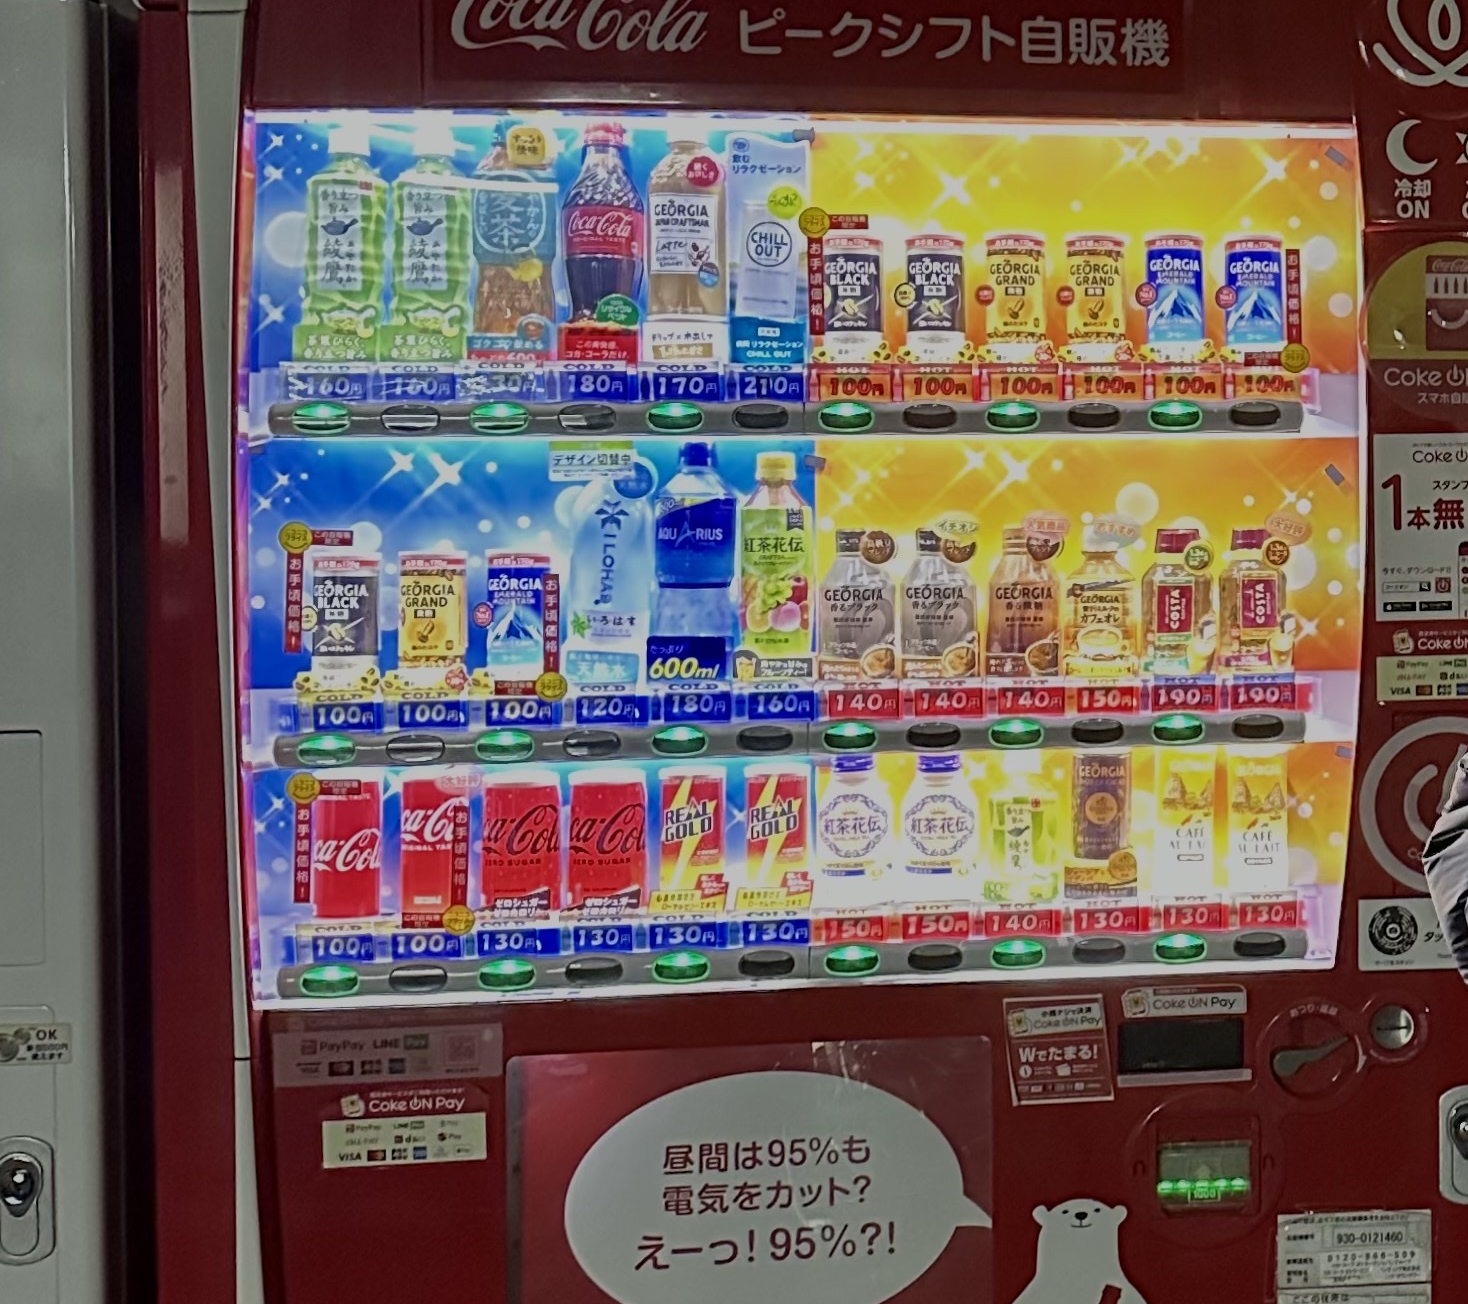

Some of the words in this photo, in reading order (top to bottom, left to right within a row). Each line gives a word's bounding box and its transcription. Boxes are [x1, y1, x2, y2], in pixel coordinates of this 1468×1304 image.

[738, 8, 1171, 69] ピークシフト自販機
[1394, 178, 1432, 197] 冷却
[654, 198, 710, 218] GEORGIA
[1396, 200, 1431, 219] ON
[567, 211, 634, 239] Coca-Cola
[750, 231, 789, 246] CHILL
[754, 243, 783, 259] OUT
[909, 258, 962, 276] GEORGIA
[989, 259, 1041, 275] GEORGIA
[1069, 260, 1121, 276] GEORGIA
[1149, 254, 1201, 272] GEORGIA
[1229, 257, 1281, 275] GEORGIA
[829, 274, 871, 286] BLACK
[914, 274, 956, 287] BLACK
[995, 274, 1036, 286] GRAND
[1075, 275, 1115, 287] GRAND
[567, 374, 625, 394] 180円
[658, 375, 718, 395] 170円
[744, 375, 801, 395] 210円
[1000, 376, 1054, 396] 100円
[1084, 375, 1136, 395] 100円
[1164, 375, 1216, 395] 100円
[1244, 374, 1295, 394] 100円
[1383, 367, 1442, 387] Coke
[830, 377, 884, 396] 100円
[914, 377, 967, 396] 100円
[552, 453, 632, 466] デザイン切替中
[1412, 450, 1453, 463] Coke
[743, 536, 805, 553] 紅茶花伝
[401, 580, 456, 597] GEORGIA
[488, 573, 543, 591] GEORGIA
[824, 585, 884, 602] GEORGIA
[906, 583, 965, 600] GEORGIA
[995, 583, 1054, 601] GEORGIA
[1080, 592, 1121, 604] GEORGIA
[317, 596, 360, 609] BLACK
[405, 596, 448, 608] GRAND
[830, 603, 879, 613] 香るブラック
[911, 600, 960, 611] 香るブラック
[1169, 588, 1181, 631] COSTA
[1255, 582, 1266, 625] COSTA
[1417, 638, 1452, 651] Coke
[649, 657, 720, 680] 600ml
[671, 696, 726, 714] 180円
[756, 696, 810, 712] 160円
[836, 694, 897, 711] 140円
[921, 692, 980, 710] 140円
[1003, 691, 1062, 708] 140円
[1081, 691, 1132, 708] 150円
[316, 706, 374, 724] 100円
[490, 701, 551, 719] 100円
[1079, 761, 1126, 778] GEORGIA
[664, 799, 710, 824] REAL
[750, 799, 795, 821] REAL
[664, 815, 713, 843] GOLD
[750, 815, 798, 841] GOLD
[824, 815, 882, 835] 紅茶花伝
[911, 815, 969, 835] 紅茶花伝
[992, 914, 1050, 931] 140円
[1080, 912, 1136, 929] 130円
[1168, 907, 1220, 924] 130円
[1245, 905, 1296, 922] 130円
[654, 926, 716, 944] 130円
[747, 923, 809, 941] 130円
[829, 921, 882, 938] 150円
[908, 917, 968, 935] 150円
[397, 935, 459, 953] 100円
[482, 933, 534, 950] 130円
[578, 928, 631, 945] 130円
[316, 938, 372, 955] 100円
[1152, 998, 1186, 1011] Coke
[1187, 995, 1208, 1009] ON
[1211, 996, 1236, 1010] Pay
[1080, 1015, 1101, 1028] Pay
[36, 1029, 57, 1041] OK
[1019, 1045, 1099, 1063] Wでたまる!
[369, 1098, 407, 1113] Coke
[409, 1095, 433, 1112] ON
[435, 1096, 466, 1112] Pay
[338, 1151, 362, 1162] VISA
[662, 1135, 871, 1176] 昼間は95%も
[662, 1175, 872, 1217] 電気をカット?
